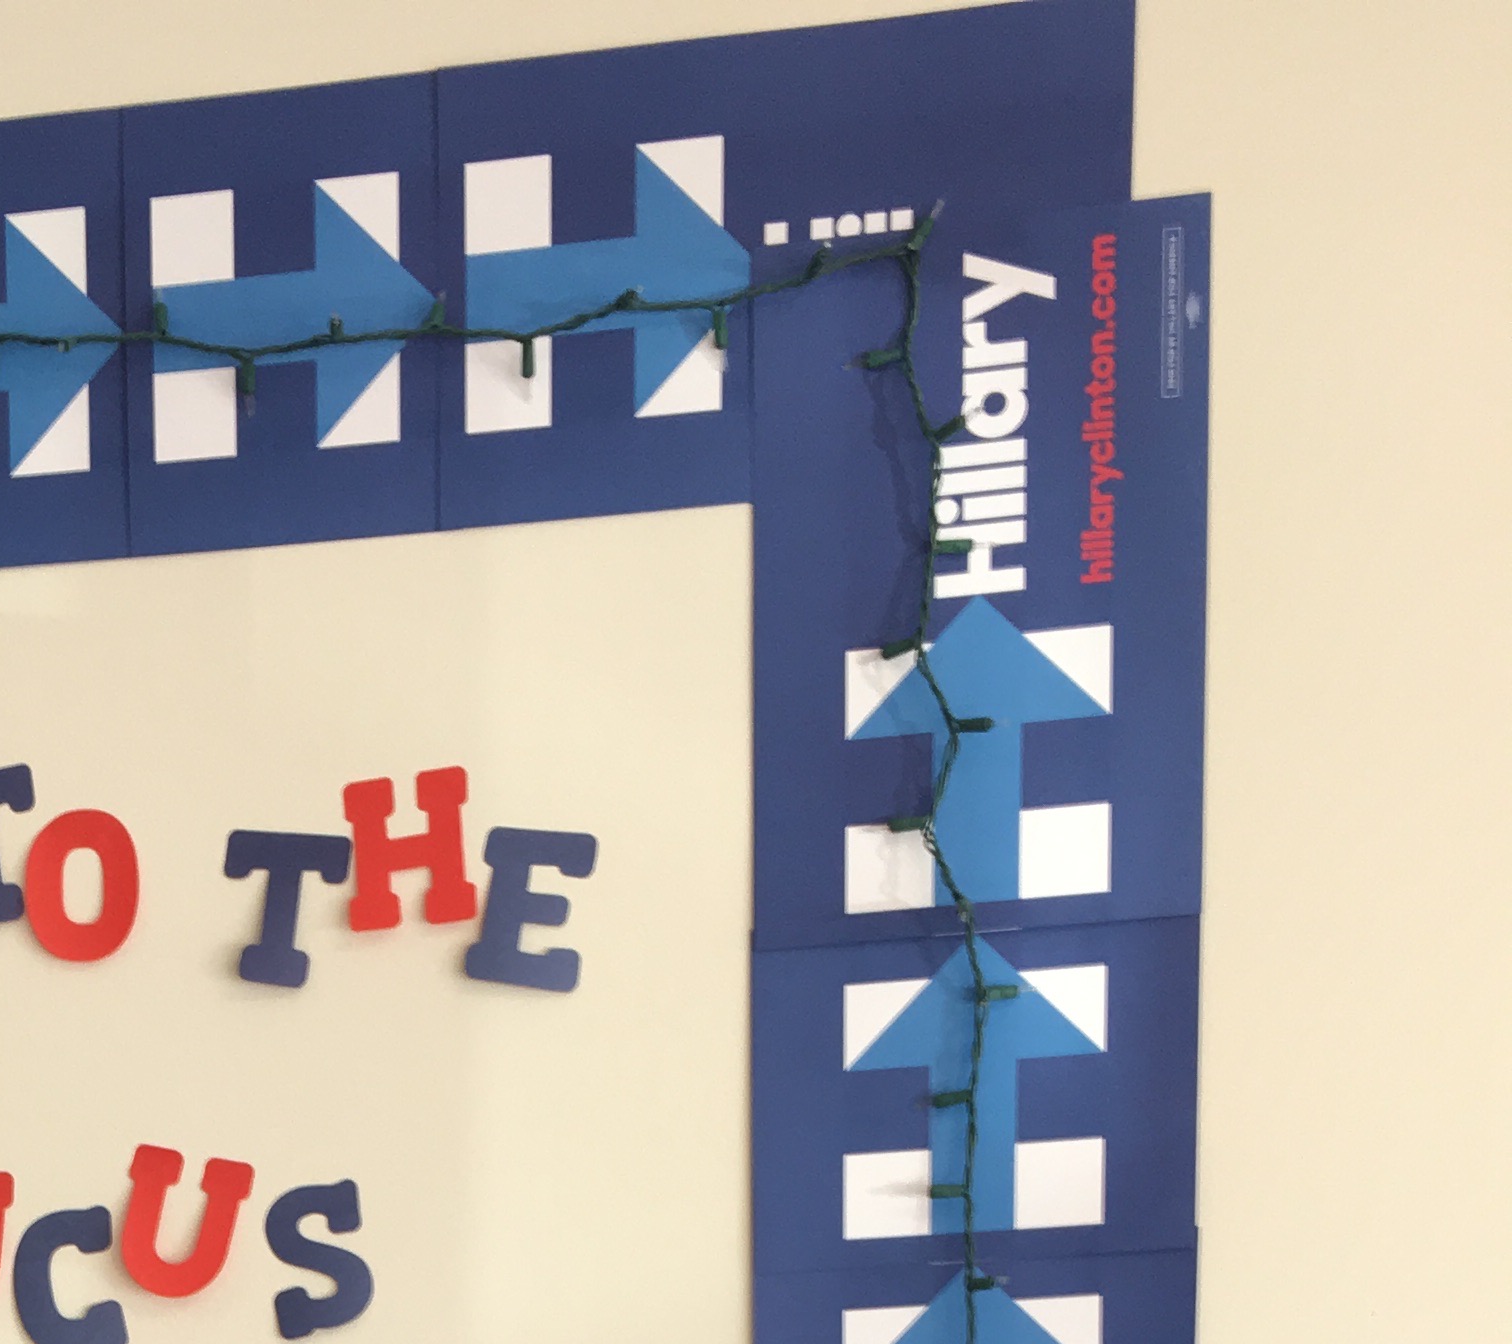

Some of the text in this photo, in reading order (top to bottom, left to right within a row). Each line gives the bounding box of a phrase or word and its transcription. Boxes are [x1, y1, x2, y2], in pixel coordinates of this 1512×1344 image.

[933, 252, 1057, 599] Hillary
[1080, 232, 1124, 584] hillaryclinton.com
[224, 766, 598, 993] THE
